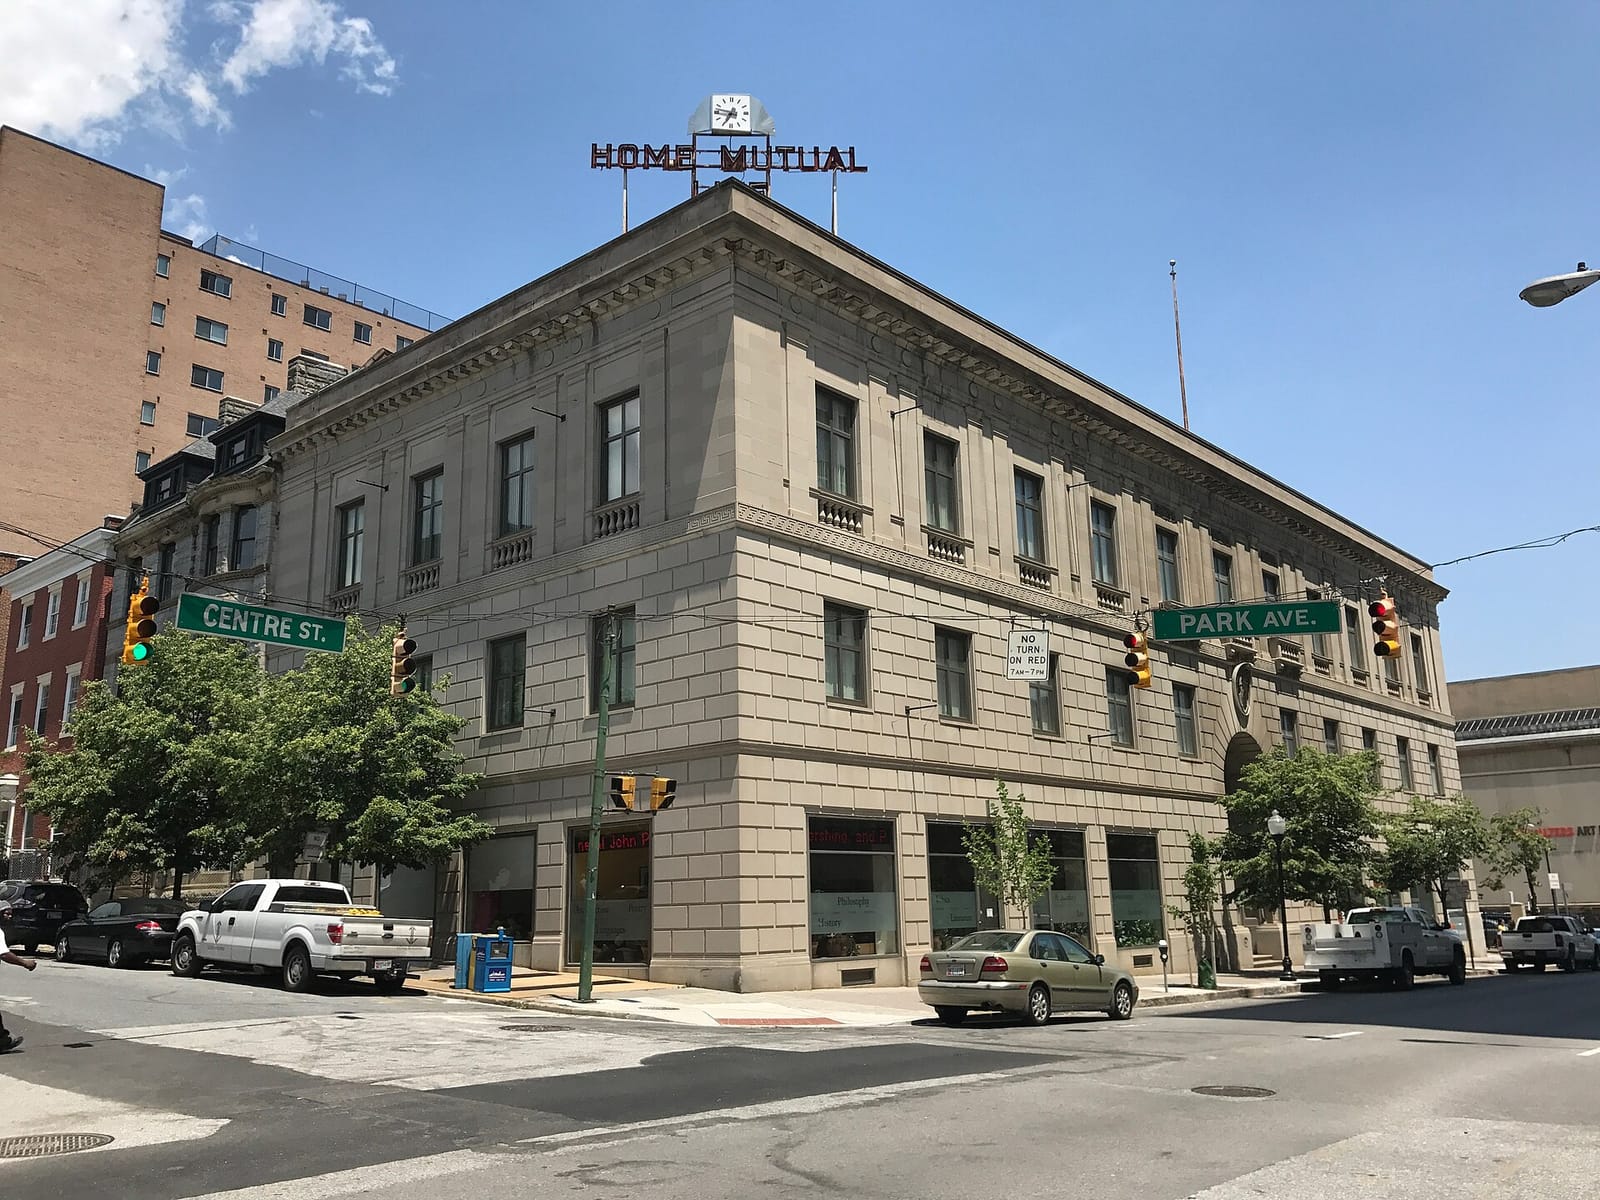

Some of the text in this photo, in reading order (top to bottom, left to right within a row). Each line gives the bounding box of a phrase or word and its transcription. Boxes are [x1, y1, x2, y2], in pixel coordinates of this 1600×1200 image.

[591, 143, 868, 172] HOME MUTUAL
[203, 603, 326, 643] CENTRE ST.
[1180, 609, 1317, 634] PARK AVE.
[1021, 635, 1036, 643] NO
[1016, 646, 1040, 654] TURN
[1010, 656, 1046, 664] ON RED
[1577, 825, 1597, 837] ART
